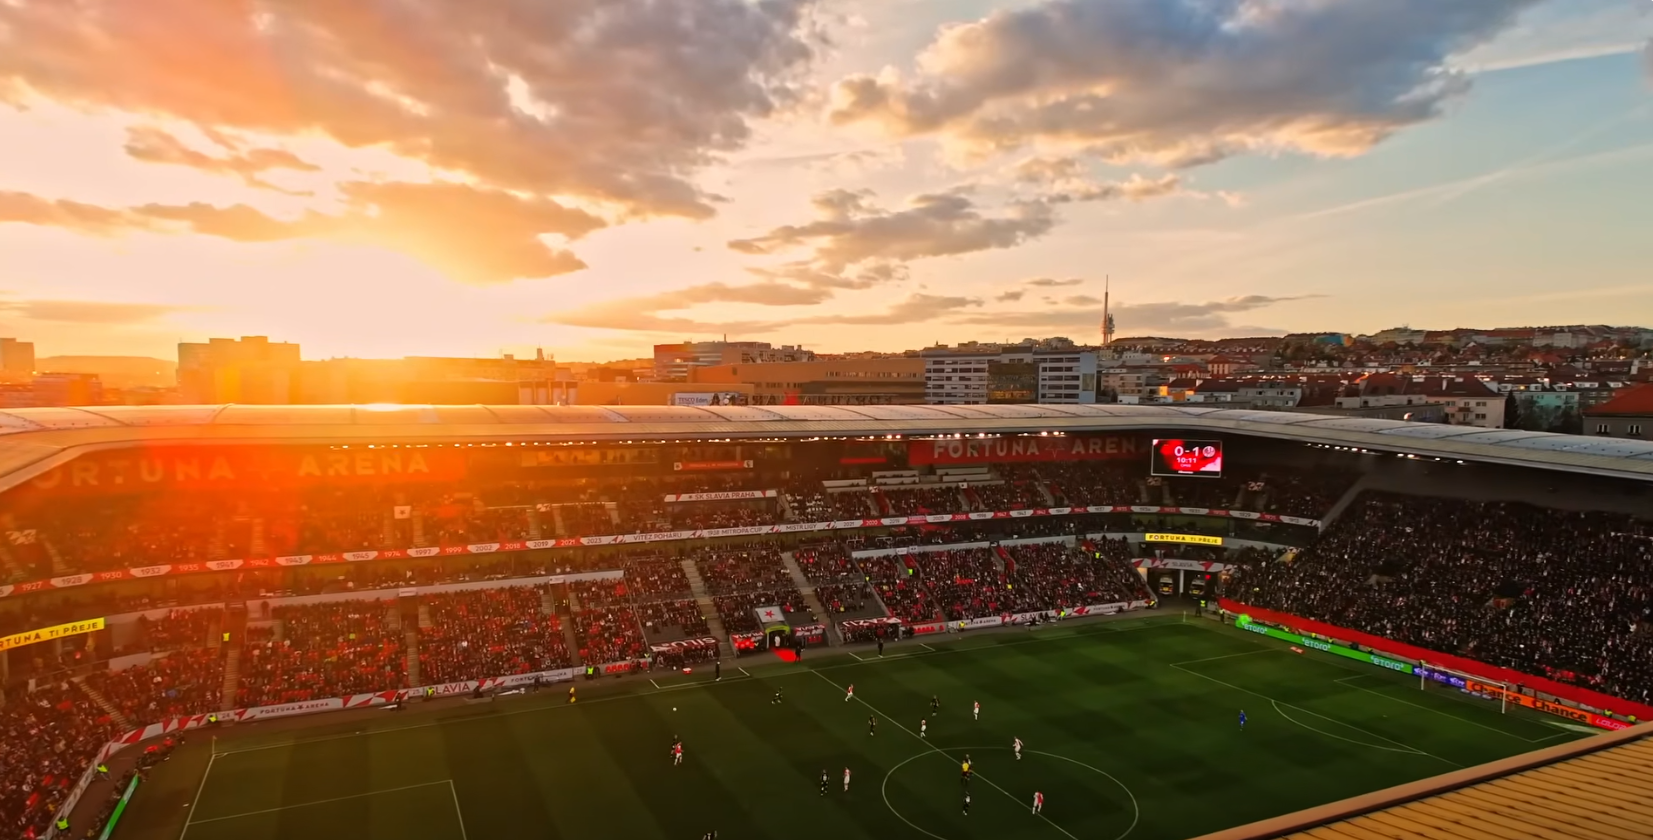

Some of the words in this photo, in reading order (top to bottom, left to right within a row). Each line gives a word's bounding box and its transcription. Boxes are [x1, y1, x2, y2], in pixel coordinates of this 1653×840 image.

[934, 440, 1040, 458] FORTUNA
[298, 454, 430, 476] ARENA
[22, 582, 43, 591] 1927
[62, 576, 82, 585] 1928
[140, 567, 161, 575] 1932
[63, 622, 98, 635] PŘEJE
[1472, 683, 1521, 704] Chance
[260, 706, 296, 714] FORTUNA
[303, 702, 329, 710] ARENA
[1532, 700, 1588, 722] Chance
